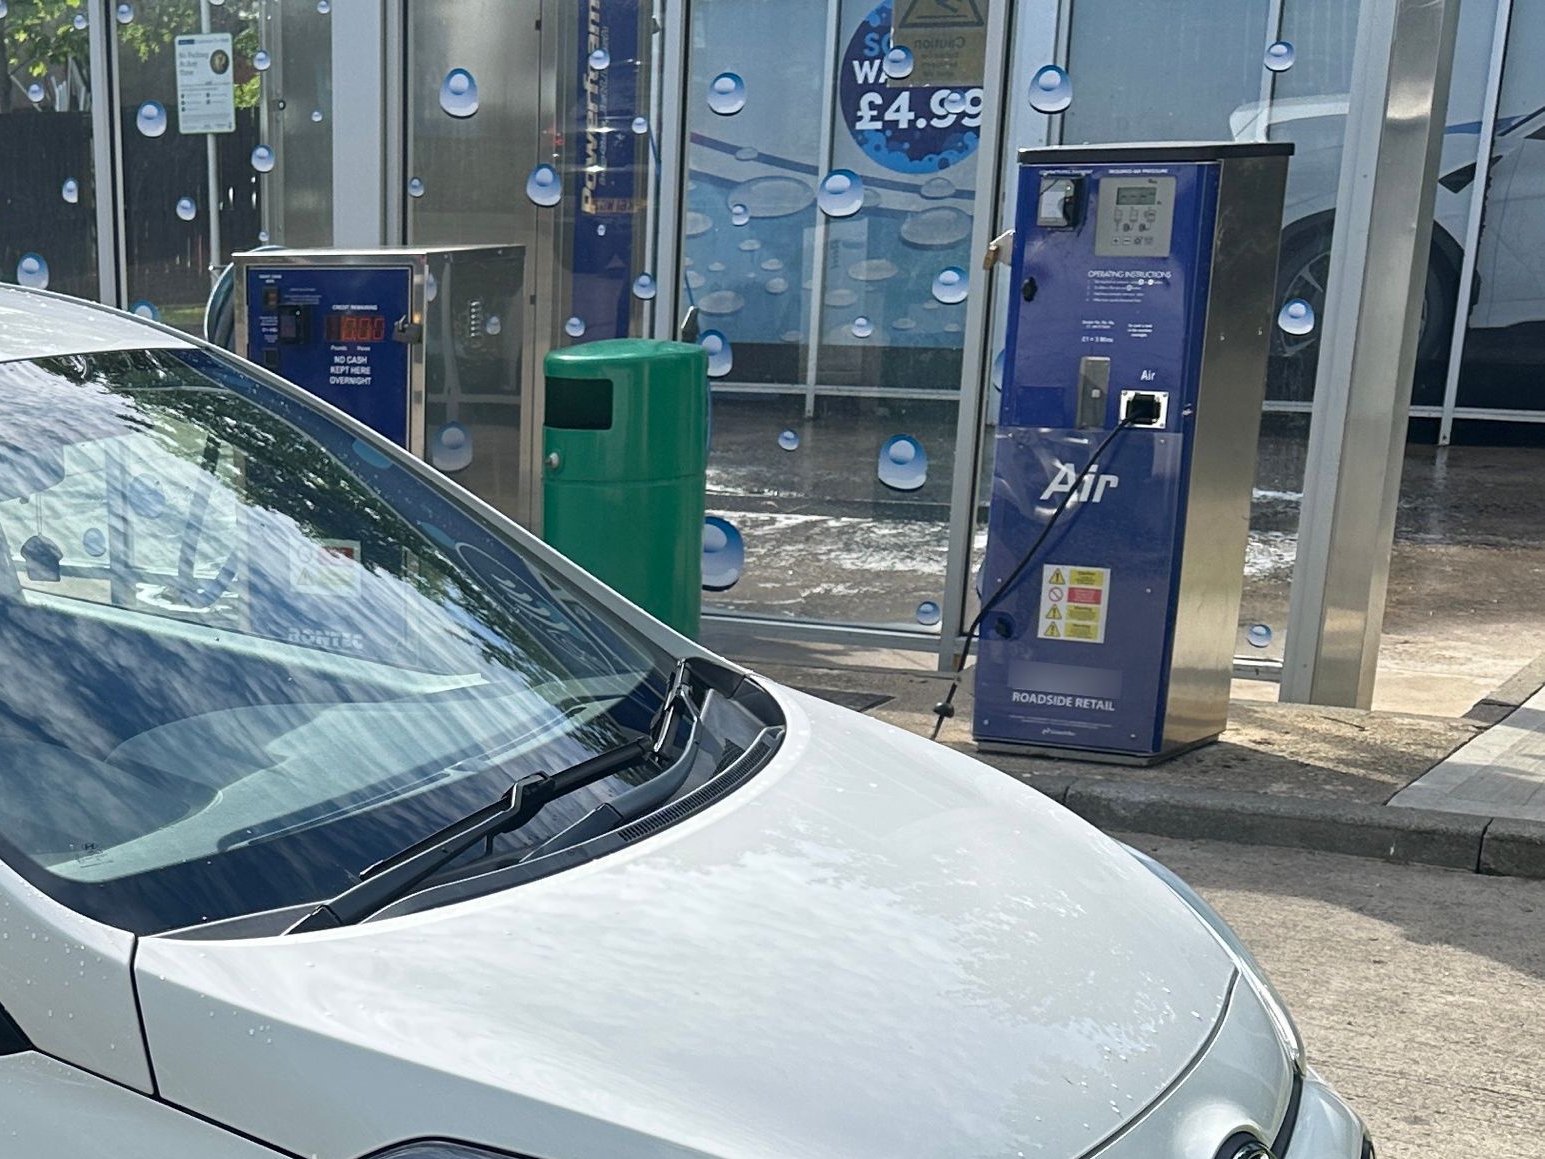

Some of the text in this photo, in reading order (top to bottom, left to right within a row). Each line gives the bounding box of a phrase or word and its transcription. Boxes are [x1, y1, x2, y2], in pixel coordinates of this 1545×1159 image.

[855, 87, 984, 130] £4.99
[1087, 270, 1172, 279] OPERATING INSTRUCTIONS
[347, 356, 368, 364] CASH
[330, 366, 371, 375] KEPT HERE
[1140, 369, 1156, 381] Air
[329, 376, 372, 385] OVERNIGHT
[1039, 462, 1119, 503] Air
[1012, 691, 1115, 711] ROADSIDE RETAIL
